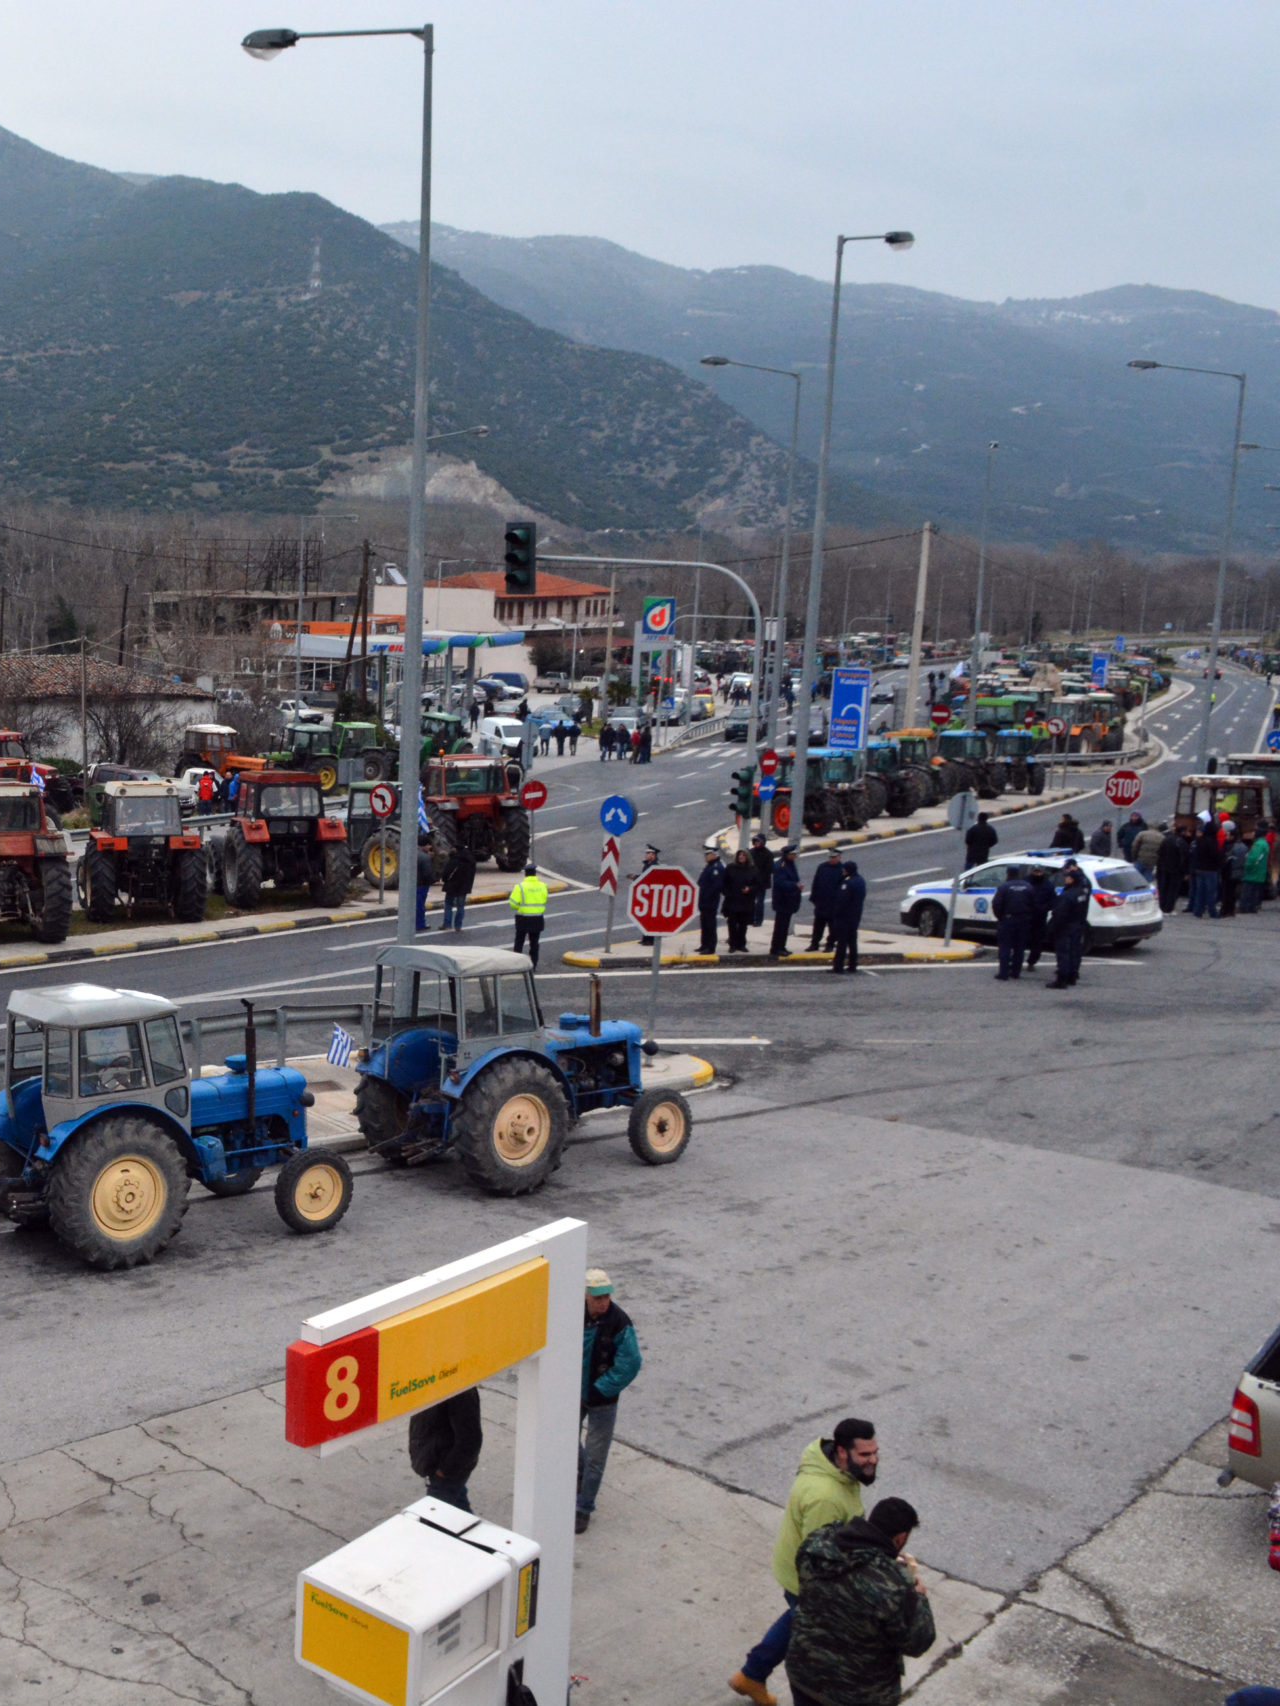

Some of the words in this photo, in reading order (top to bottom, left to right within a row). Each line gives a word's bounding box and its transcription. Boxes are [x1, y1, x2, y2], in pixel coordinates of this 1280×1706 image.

[1107, 778, 1140, 798] STOP
[634, 884, 693, 918] STOP
[323, 1355, 361, 1421] 8
[390, 1375, 436, 1400] FuelSave
[311, 1593, 349, 1620] FuelSave
